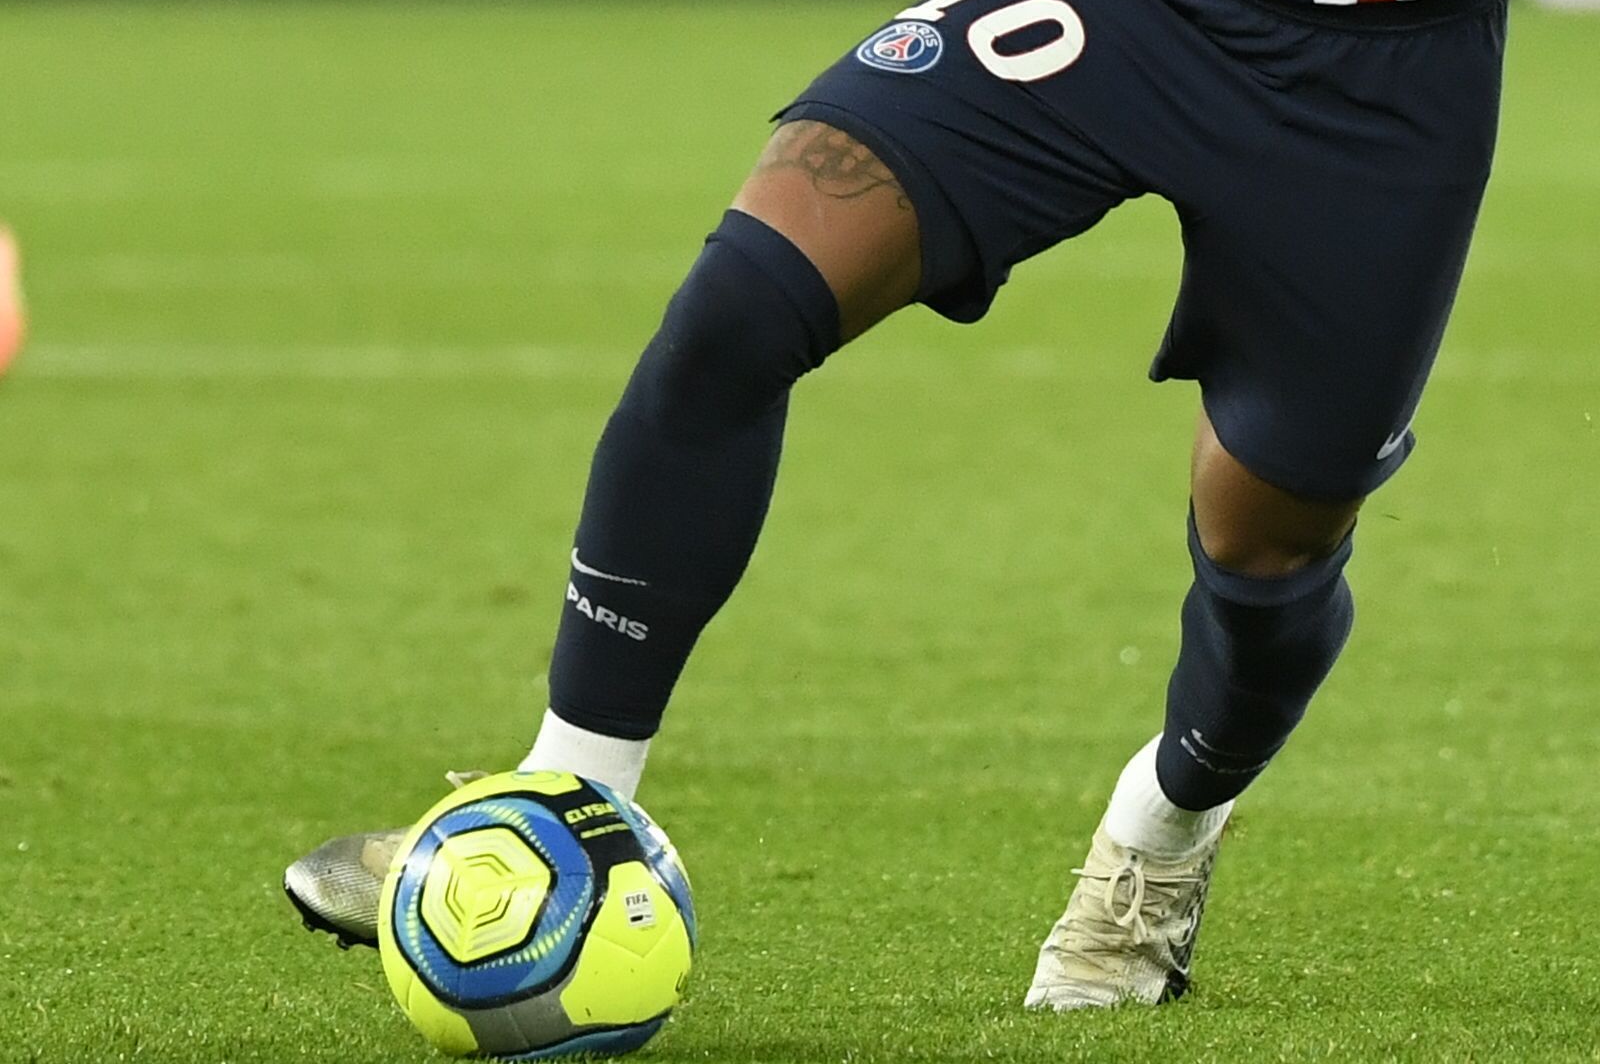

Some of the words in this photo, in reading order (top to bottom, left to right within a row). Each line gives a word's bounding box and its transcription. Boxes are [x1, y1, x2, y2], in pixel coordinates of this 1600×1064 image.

[895, 24, 940, 49] PARIS
[566, 581, 650, 642] PARIS
[625, 893, 649, 907] FIFA
